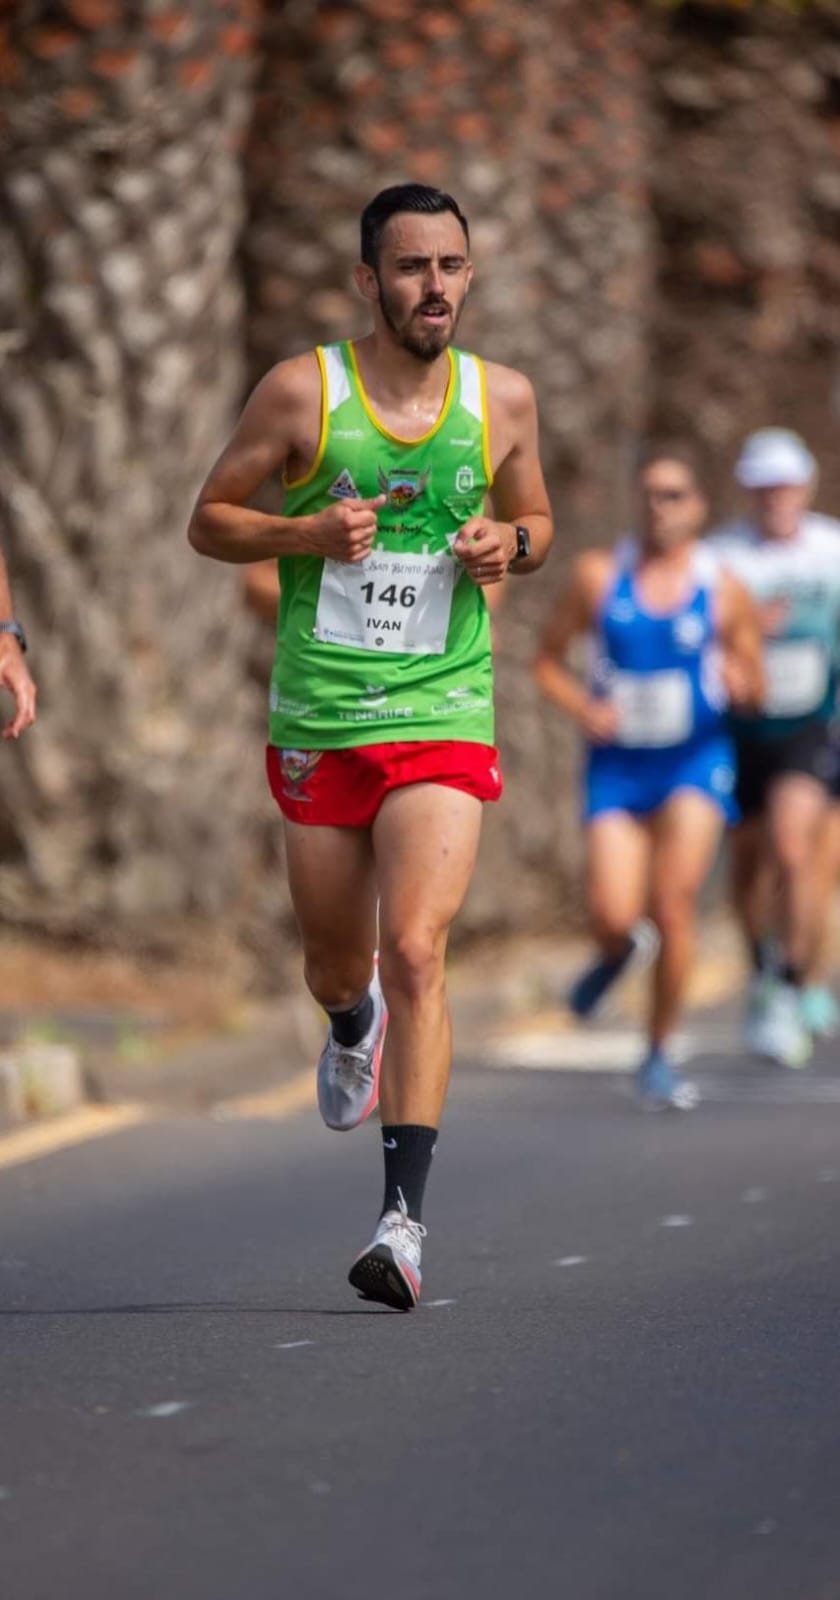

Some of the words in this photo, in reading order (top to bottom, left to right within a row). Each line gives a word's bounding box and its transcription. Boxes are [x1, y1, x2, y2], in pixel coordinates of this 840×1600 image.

[360, 581, 417, 608] 146
[366, 618, 402, 631] IVAN
[337, 707, 413, 720] TENERIFE
